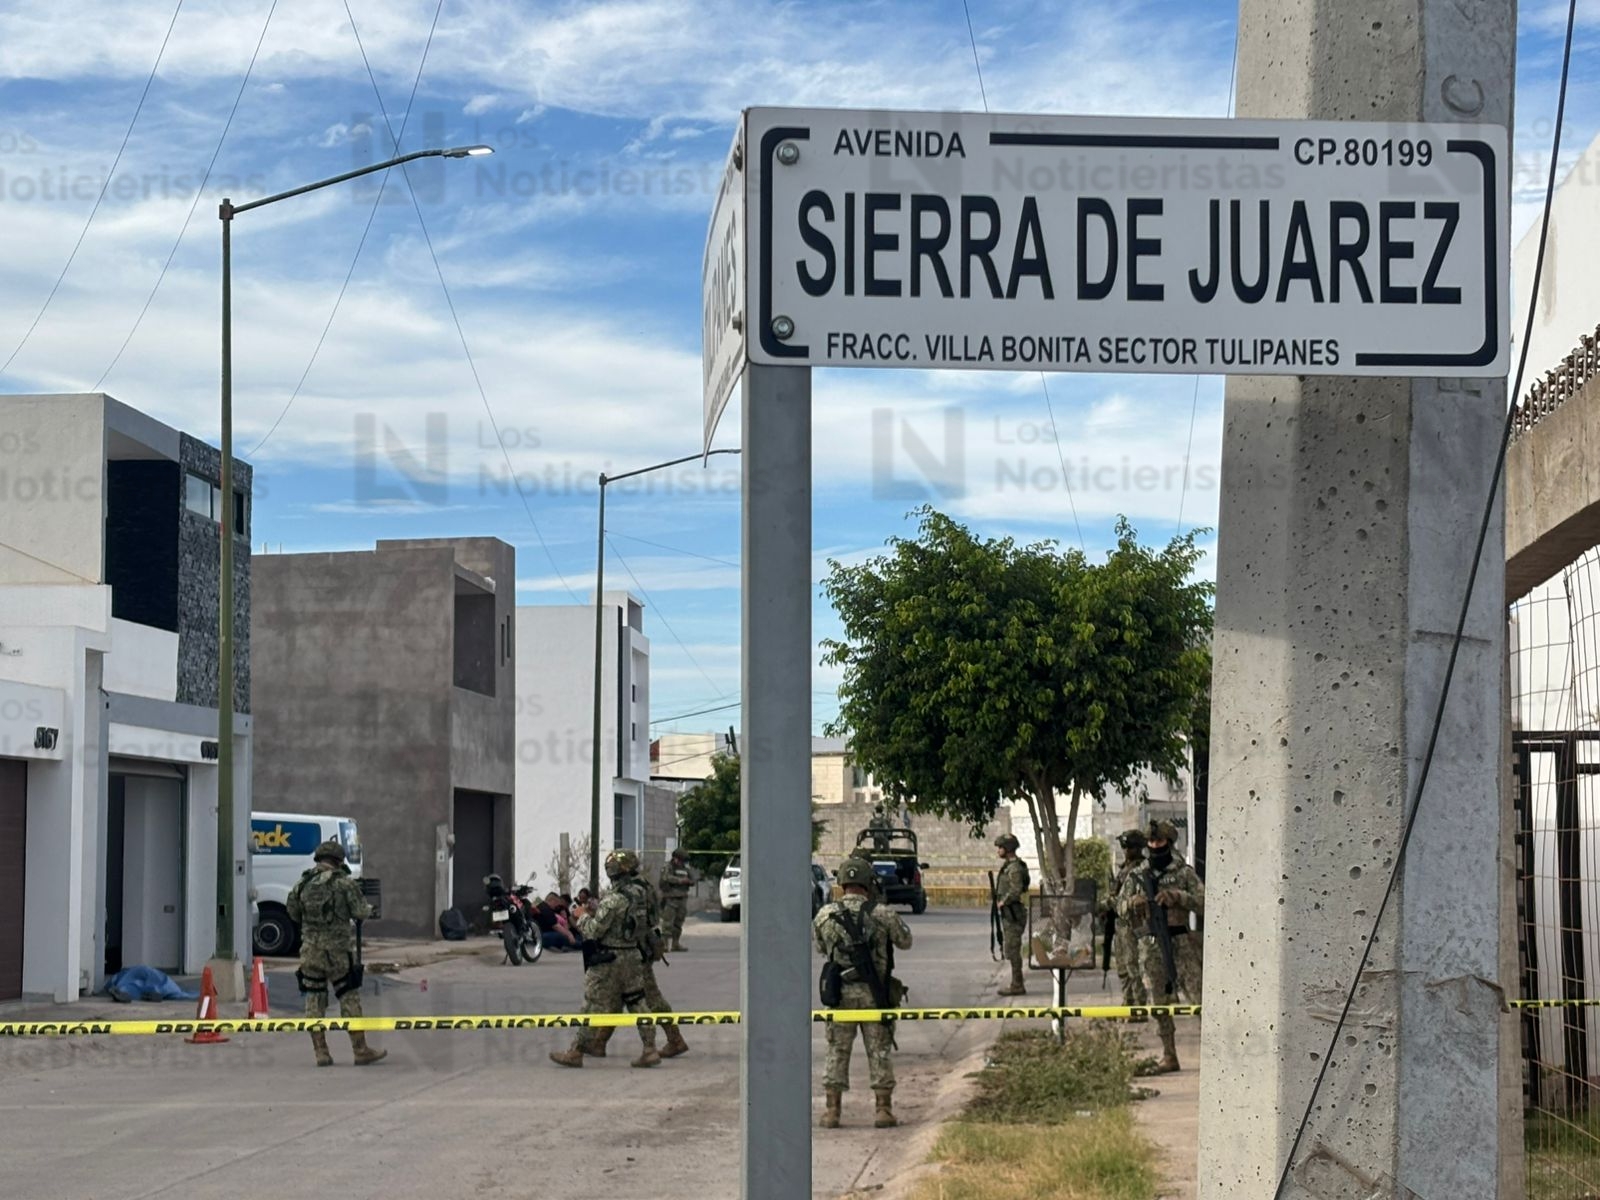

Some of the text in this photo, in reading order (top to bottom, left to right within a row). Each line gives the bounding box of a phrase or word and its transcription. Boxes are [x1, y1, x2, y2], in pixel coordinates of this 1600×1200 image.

[834, 129, 965, 158] AVENIDA
[1294, 137, 1434, 167] CP.80199
[795, 189, 1054, 299] SIERRA
[1077, 197, 1164, 301] DE
[1188, 199, 1462, 305] JUAREZ
[828, 332, 1339, 366] FRACC. VILLA BONITA SECTOR TULIPANES
